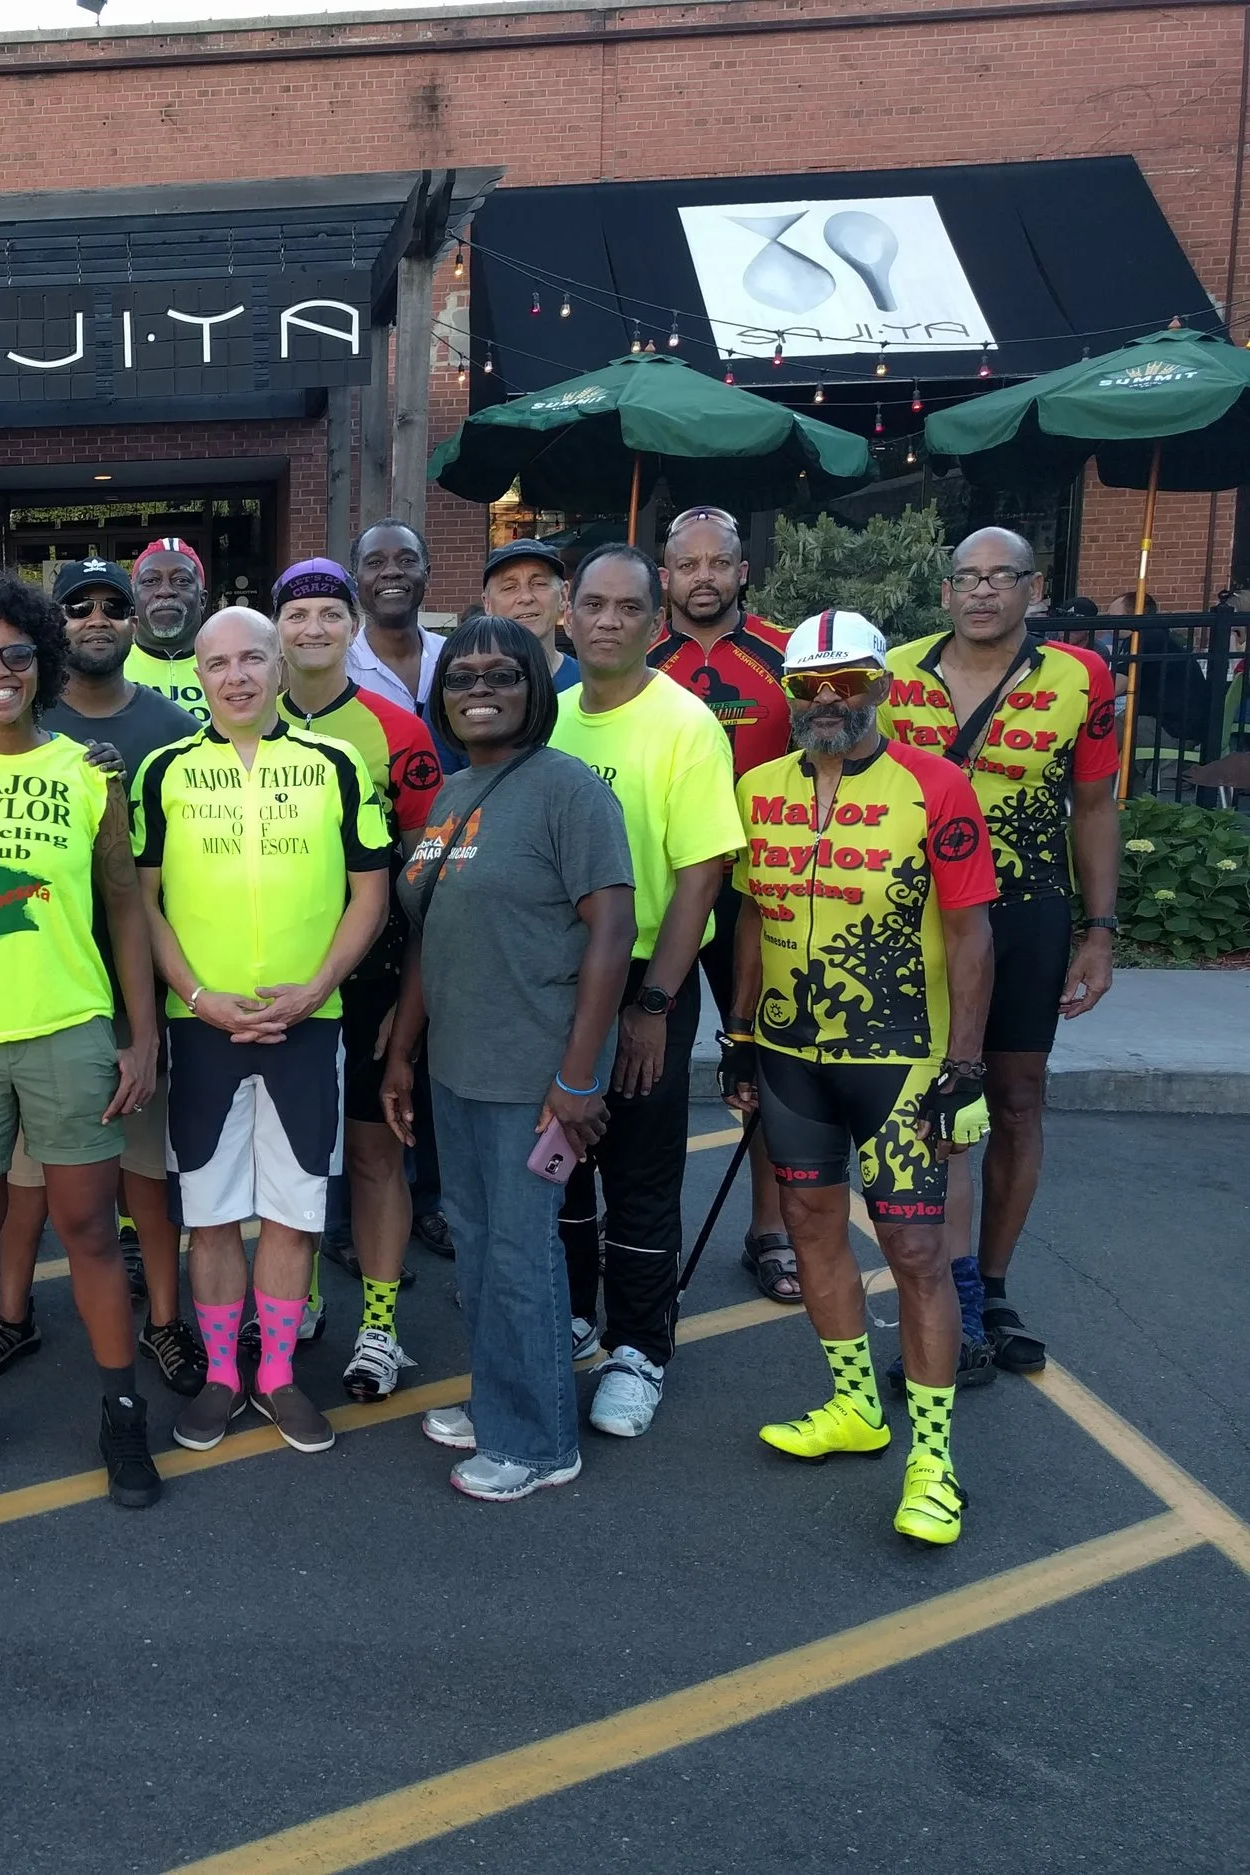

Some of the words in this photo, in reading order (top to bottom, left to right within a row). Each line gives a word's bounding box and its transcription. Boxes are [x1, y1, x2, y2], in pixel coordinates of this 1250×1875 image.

[1098, 371, 1198, 387] SUMMIT
[531, 396, 606, 410] SUMMIT
[289, 574, 322, 589] LET'S
[292, 582, 339, 598] CRAZY
[797, 650, 850, 664] FLANDERS
[183, 767, 243, 791] MAJOR
[259, 763, 326, 788] TAYLOR
[181, 804, 244, 820] CYCLING
[259, 804, 299, 821] CLUB
[750, 838, 892, 875] Taylor
[774, 1166, 820, 1181] ajor
[876, 1201, 944, 1218] Taylor
[831, 1401, 848, 1417] GIRO
